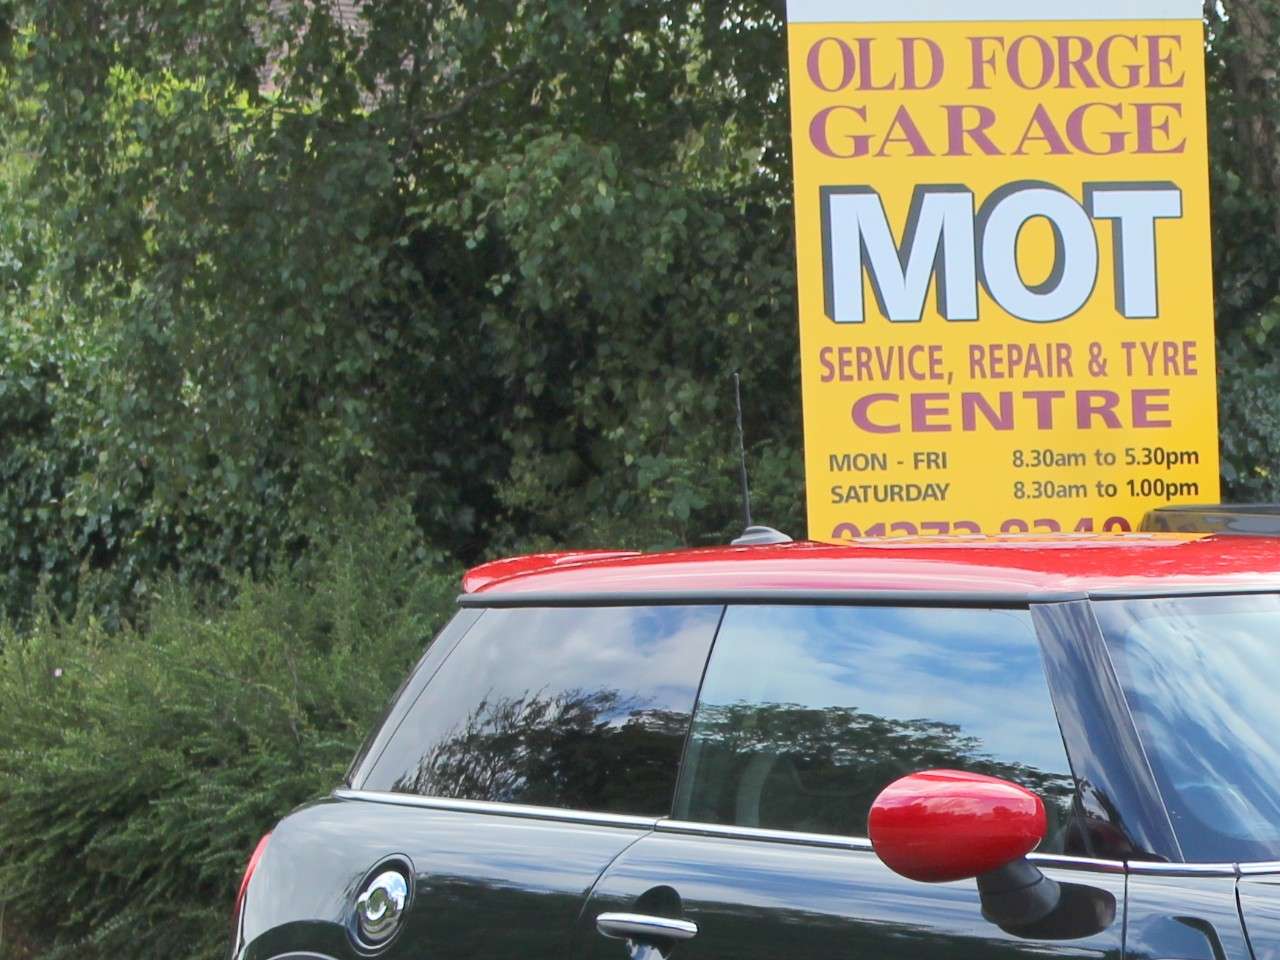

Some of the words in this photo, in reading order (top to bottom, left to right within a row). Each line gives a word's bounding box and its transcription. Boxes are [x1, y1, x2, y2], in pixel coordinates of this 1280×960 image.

[806, 36, 945, 92] OLD
[966, 34, 1186, 90] FORGE
[808, 102, 1187, 159] GARAGE
[819, 179, 1183, 324] MOT
[819, 344, 954, 384] SERVICE,
[968, 342, 1073, 380] REPAIR
[1087, 340, 1108, 377] &
[1120, 340, 1198, 377] TYRE
[850, 388, 1172, 434] CENTRE
[829, 452, 888, 473] MON
[913, 450, 948, 470] FRI
[1011, 448, 1086, 468] 8.30am
[1094, 449, 1116, 466] to
[1124, 446, 1199, 471] 5.30pm
[830, 482, 951, 504] SATURDAY
[1013, 479, 1088, 499] 8.30am
[1095, 480, 1118, 498] to
[1126, 477, 1199, 501] 1.00pm
